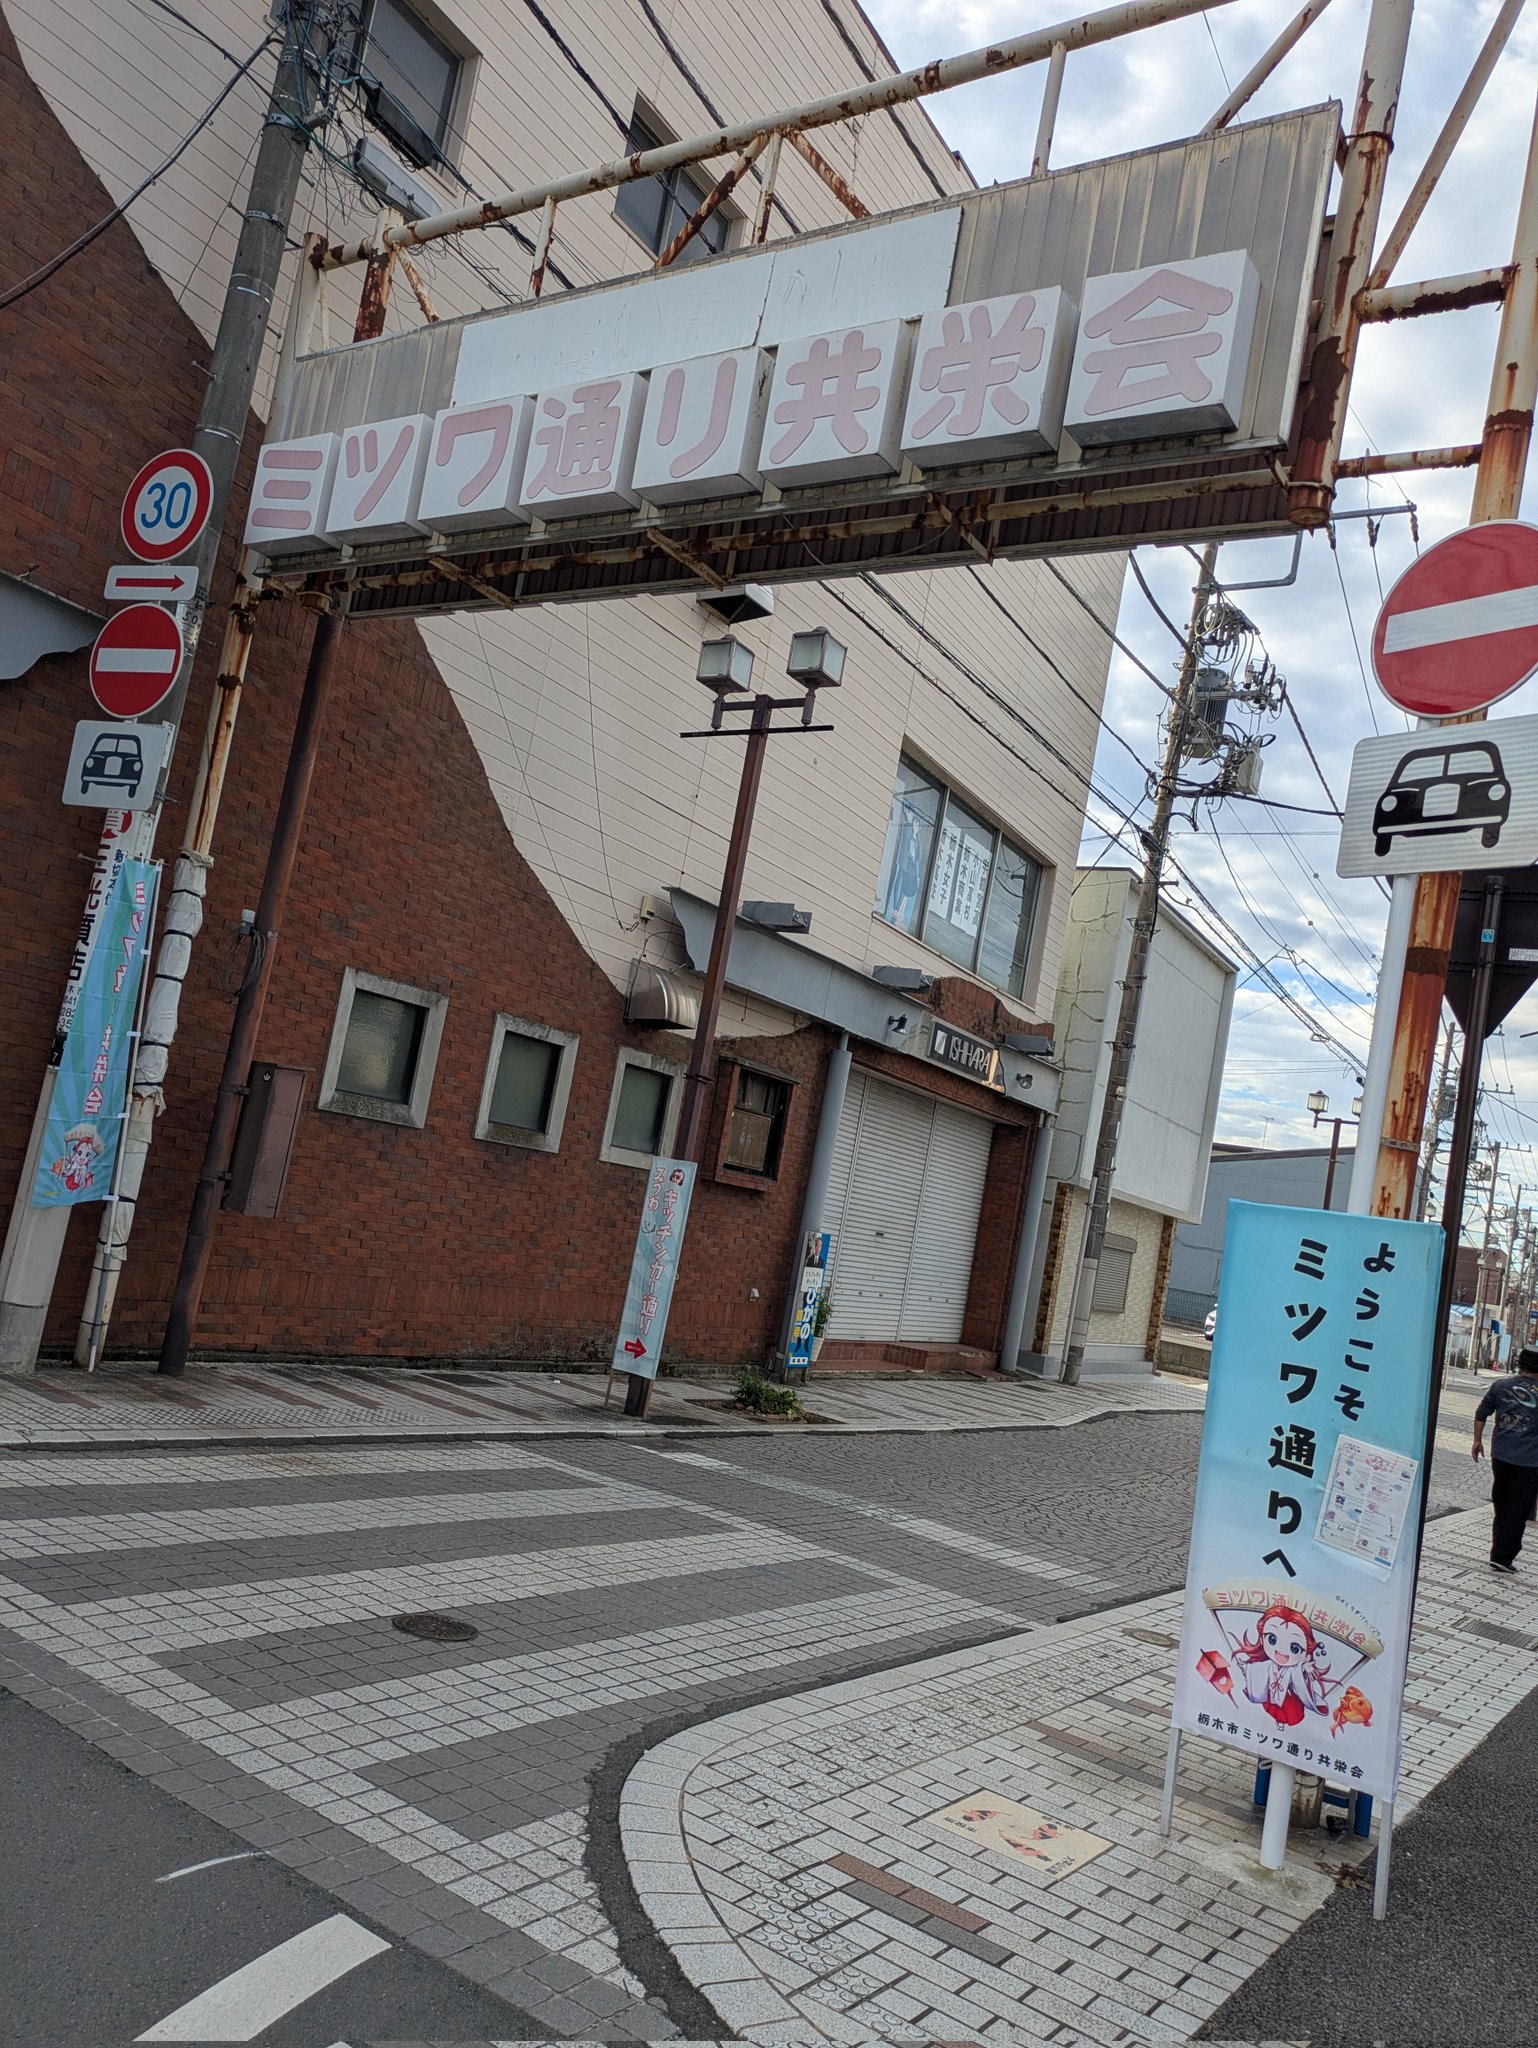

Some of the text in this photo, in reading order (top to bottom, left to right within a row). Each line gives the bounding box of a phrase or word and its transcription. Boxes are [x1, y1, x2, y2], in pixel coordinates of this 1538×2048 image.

[140, 481, 192, 529] 30
[949, 1036, 991, 1074] ISHIHARA
[648, 1167, 666, 1212] みつわ
[639, 1189, 678, 1335] キッチンカー通り
[1333, 1242, 1396, 1422] ようこそ
[1262, 1238, 1329, 1578] ミツワ通りへ
[1197, 1712, 1365, 1779] 栃木市ミツワ通り共栄会
